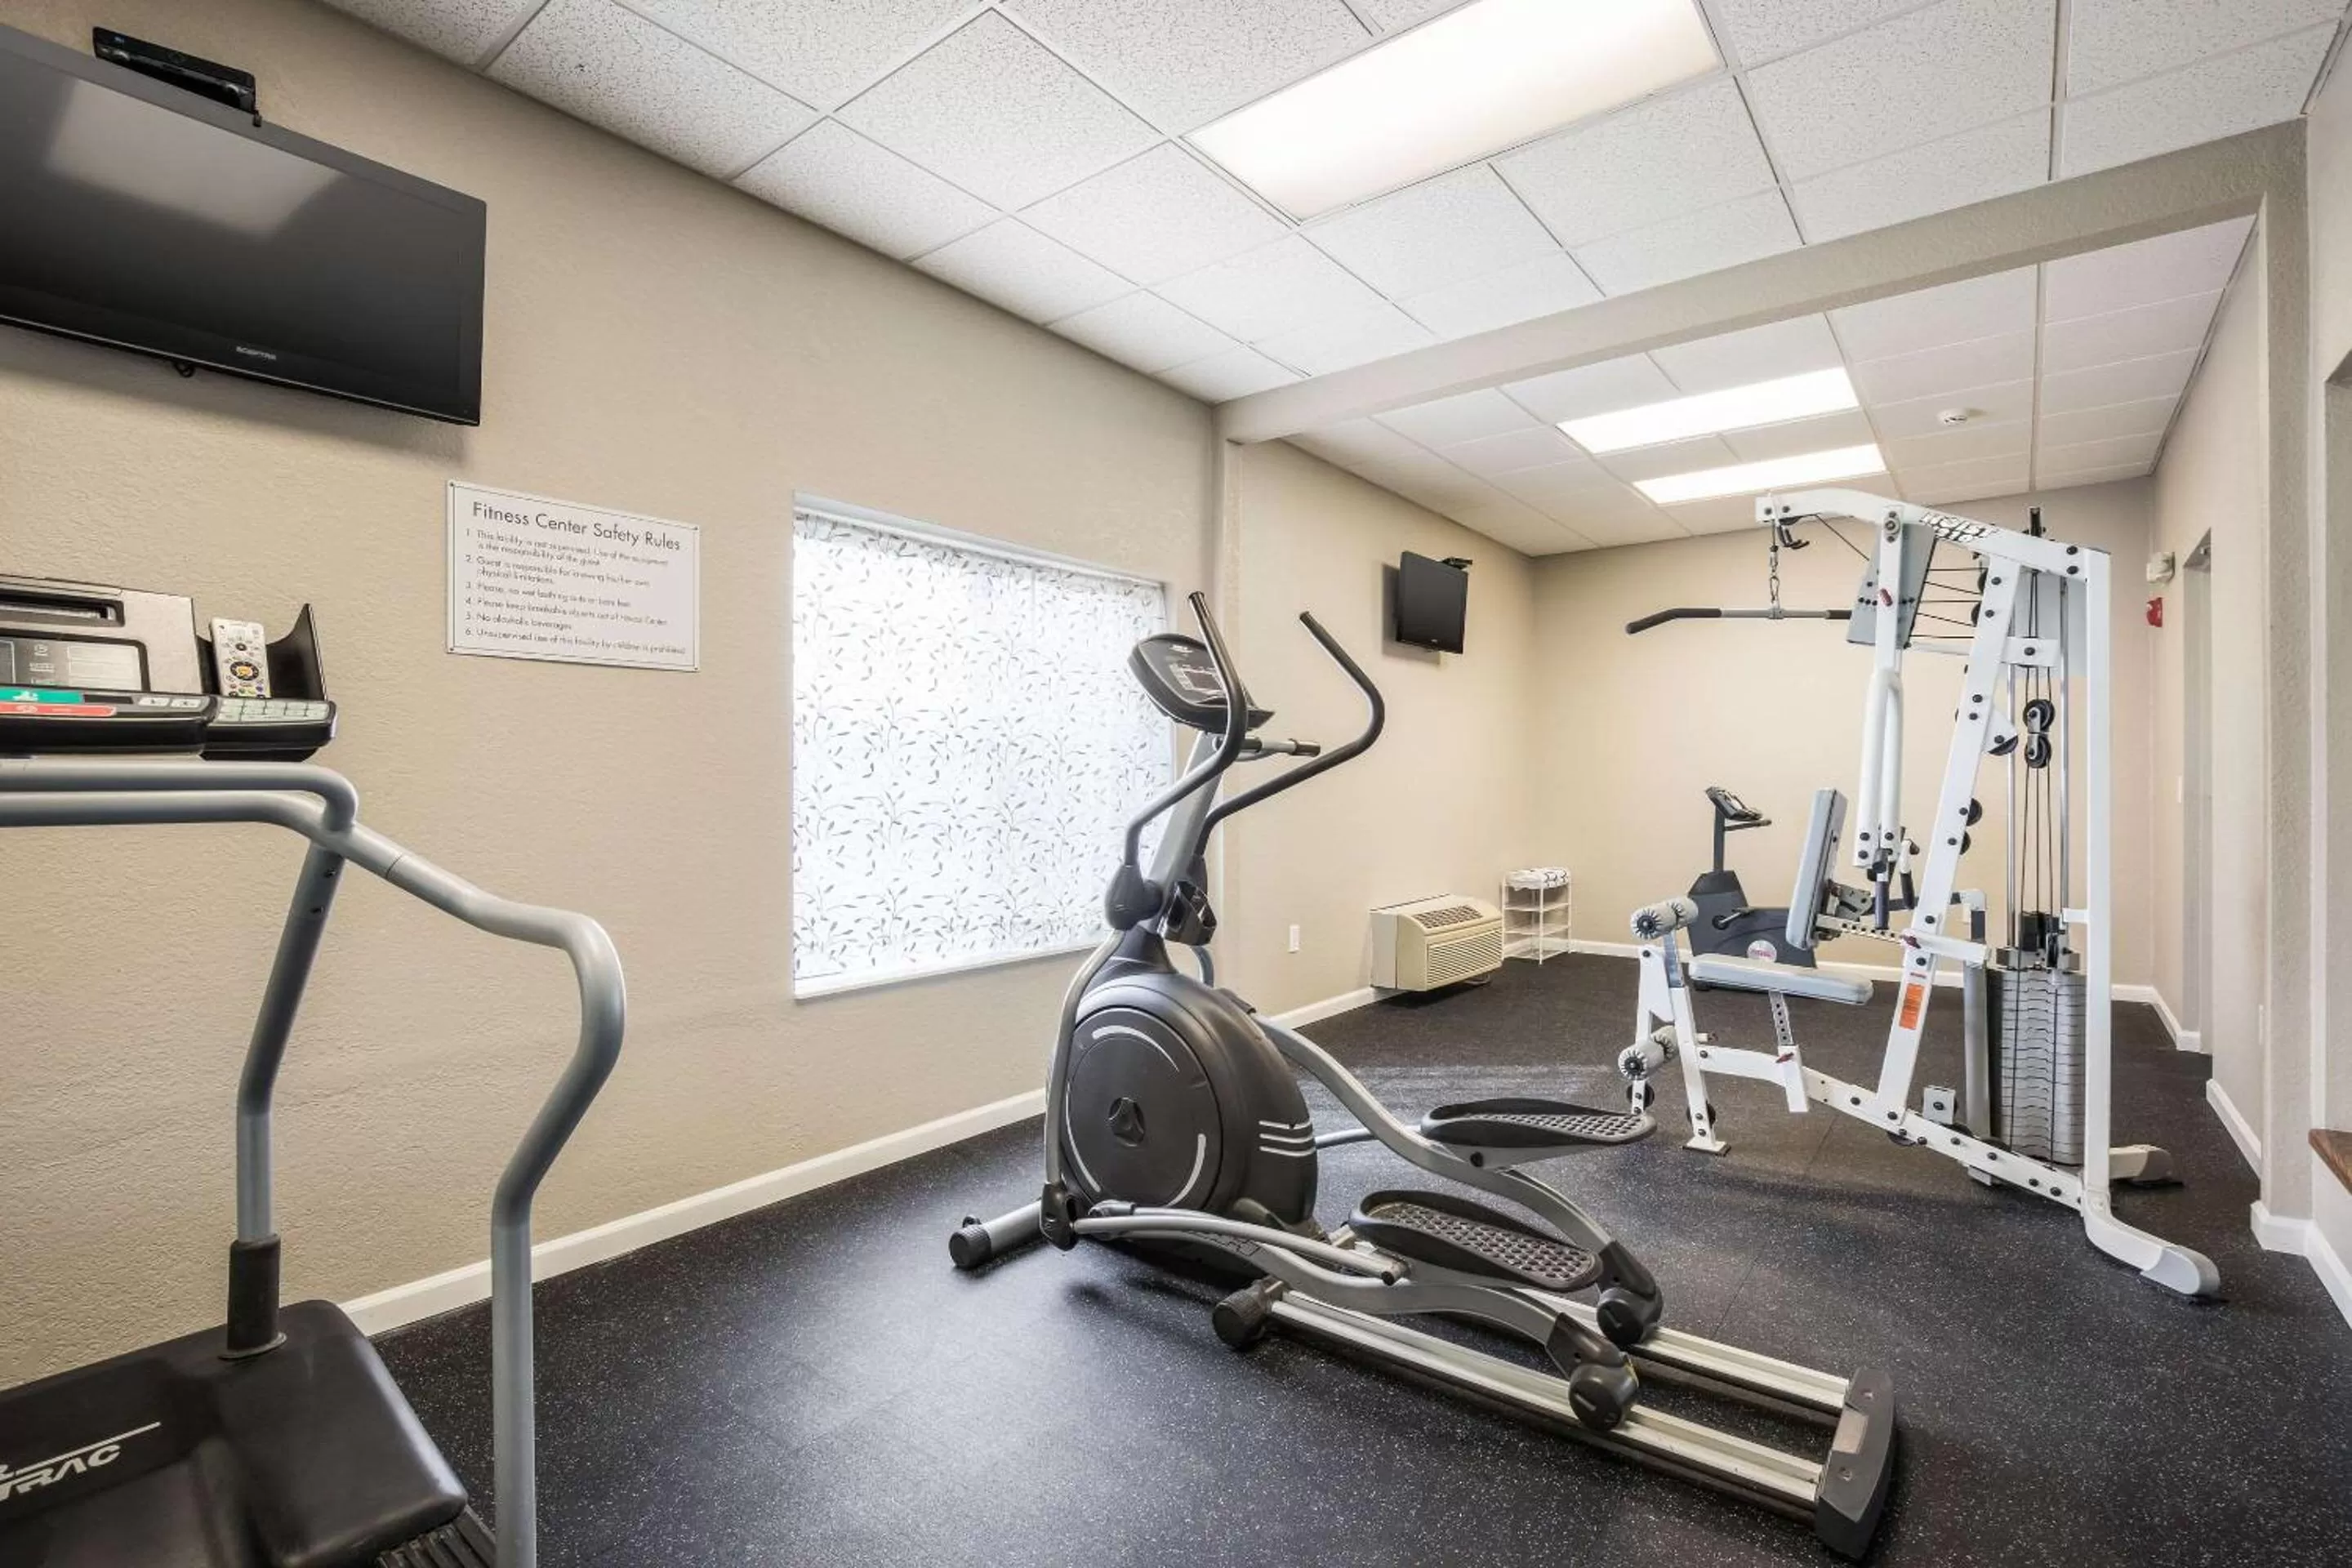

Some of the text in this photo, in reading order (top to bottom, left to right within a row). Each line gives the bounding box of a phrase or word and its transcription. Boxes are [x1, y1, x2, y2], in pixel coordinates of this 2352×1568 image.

[473, 501, 680, 550] Fitness Center Safety Rules
[476, 529, 494, 541] This
[476, 555, 501, 567] Guest
[476, 612, 490, 622] No
